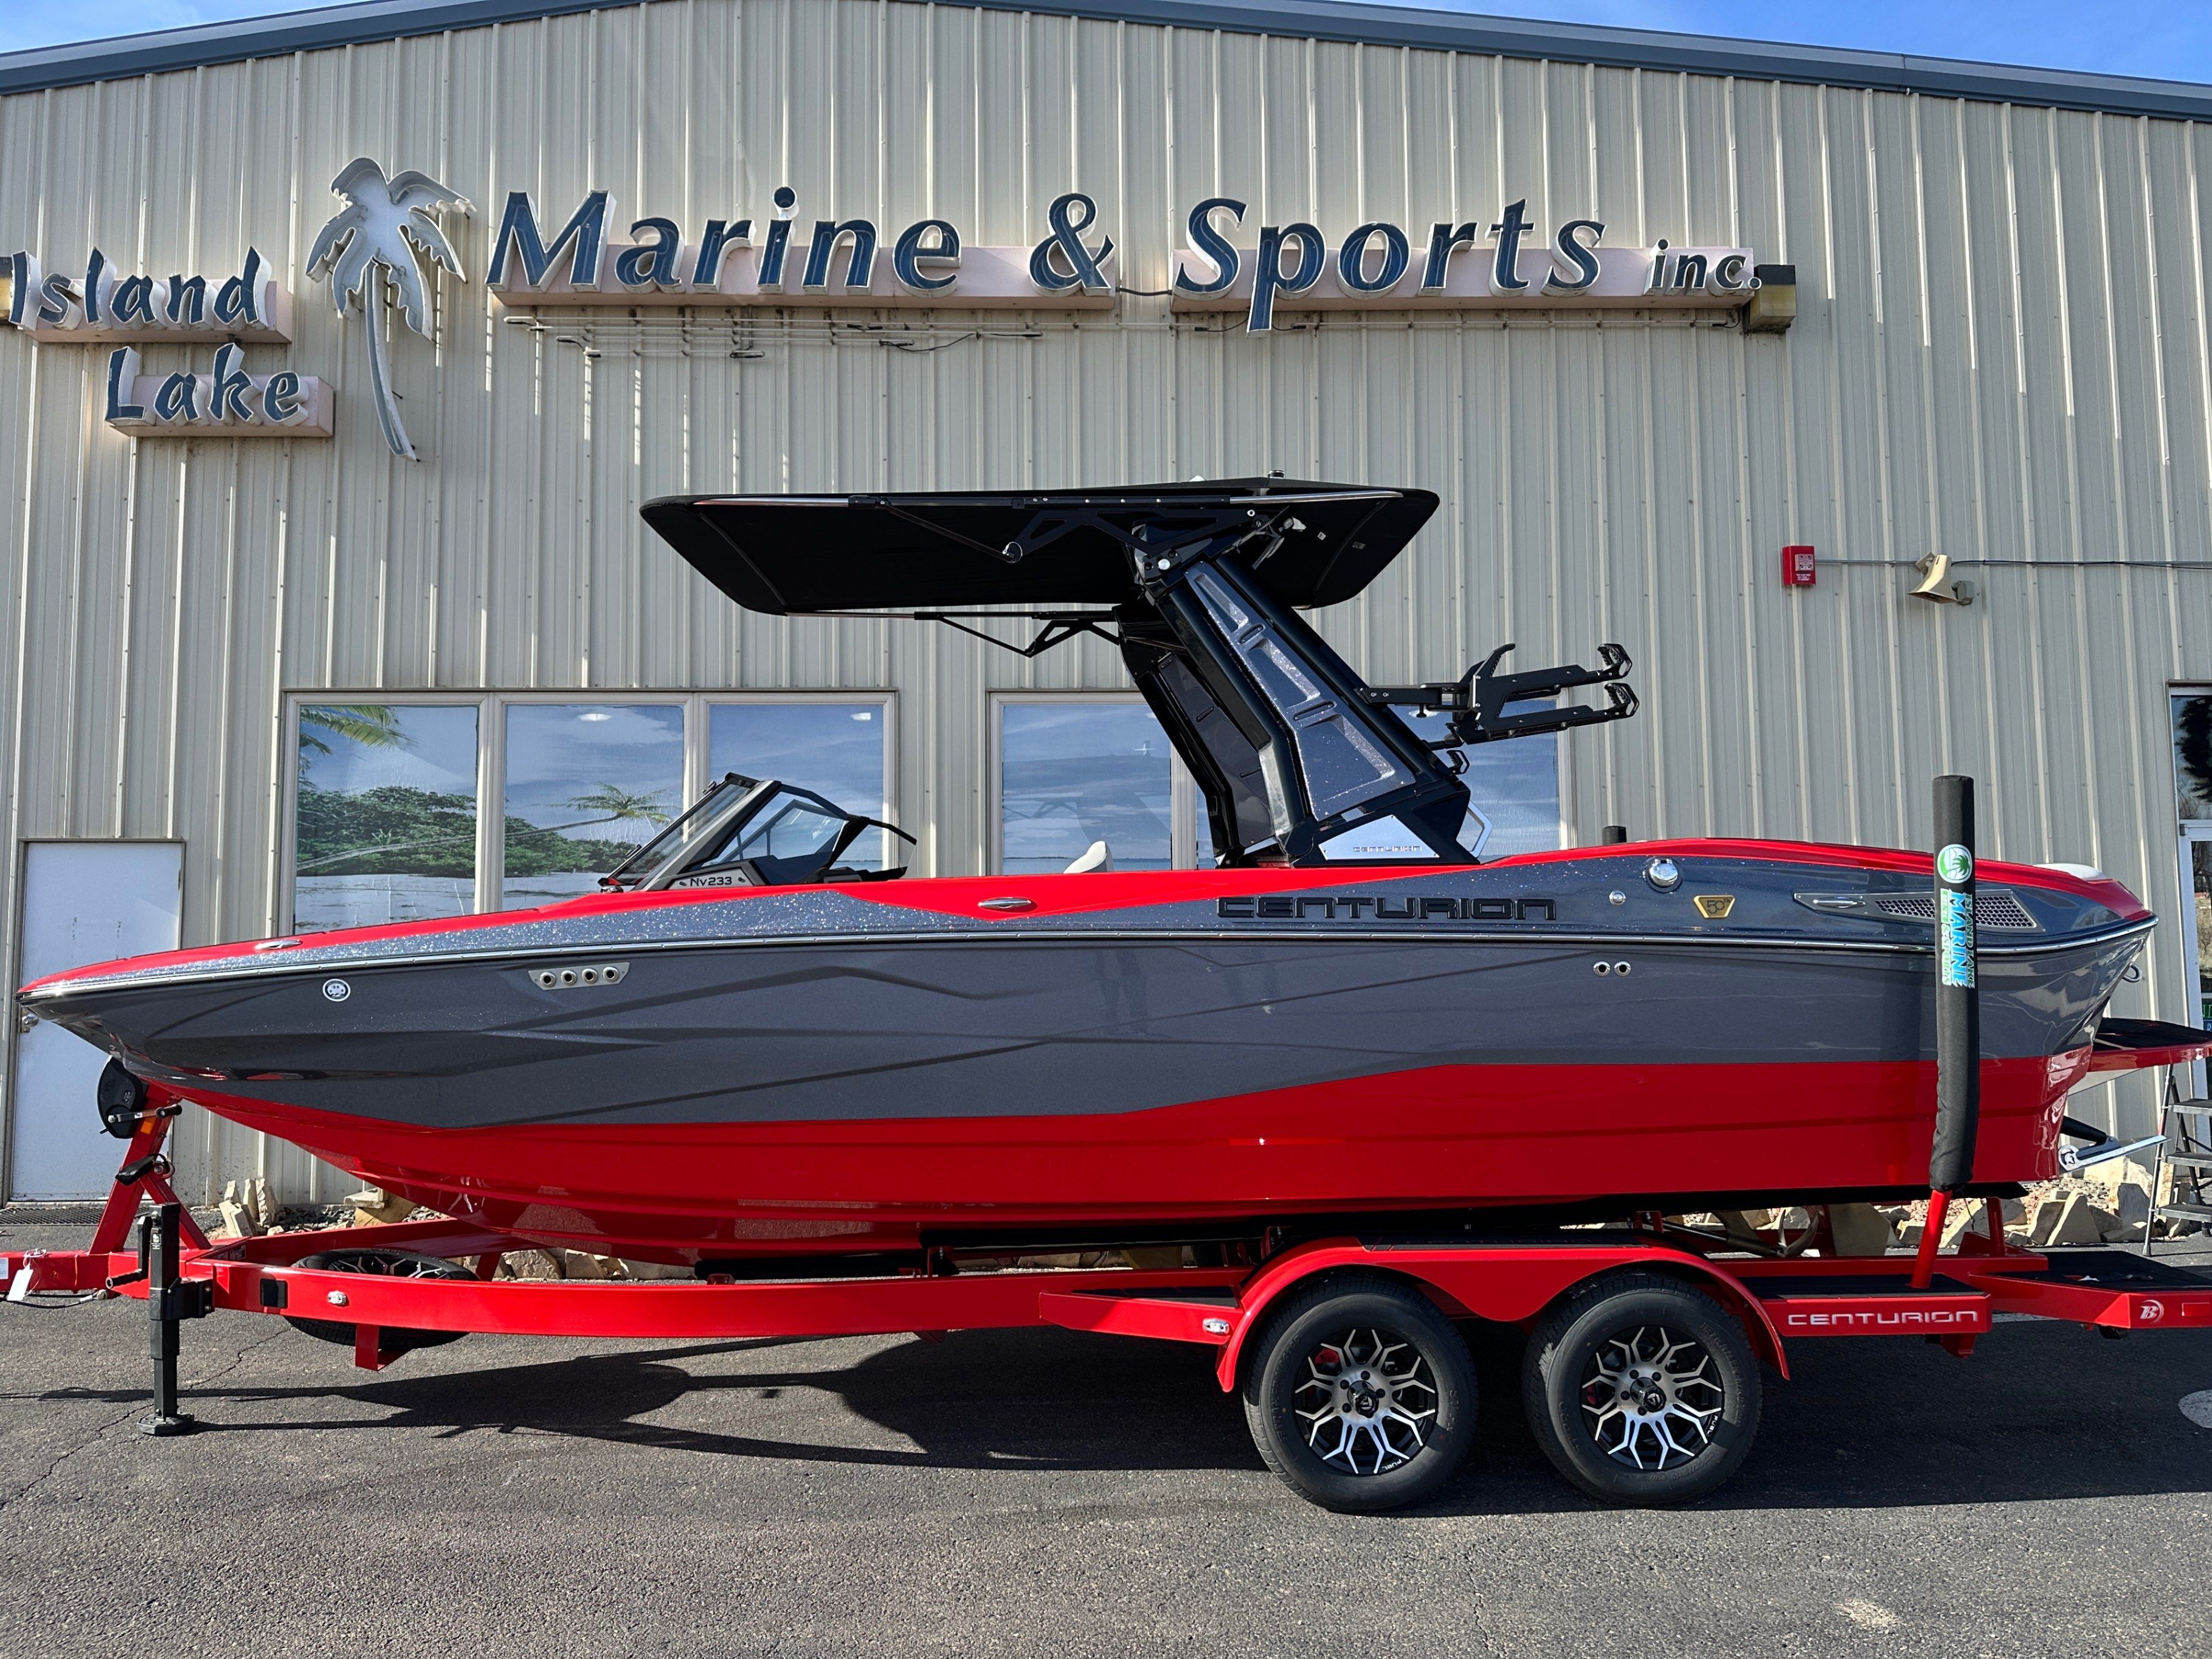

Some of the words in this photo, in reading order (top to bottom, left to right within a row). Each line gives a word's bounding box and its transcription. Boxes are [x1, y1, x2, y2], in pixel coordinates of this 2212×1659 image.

[9, 246, 264, 327] Island
[485, 186, 961, 294] Marine
[1029, 193, 1116, 295] &
[1173, 197, 1607, 335] Sports
[1647, 238, 1761, 291] inc.
[105, 342, 302, 423] Lake
[690, 876, 732, 887] Nv233
[1217, 896, 1557, 921] CENTURION
[1951, 891, 1967, 988] MARINE
[1965, 893, 1974, 949] ISLAND
[1966, 949, 1975, 989] LAKE
[1788, 1311, 1979, 1325] CENTURION
